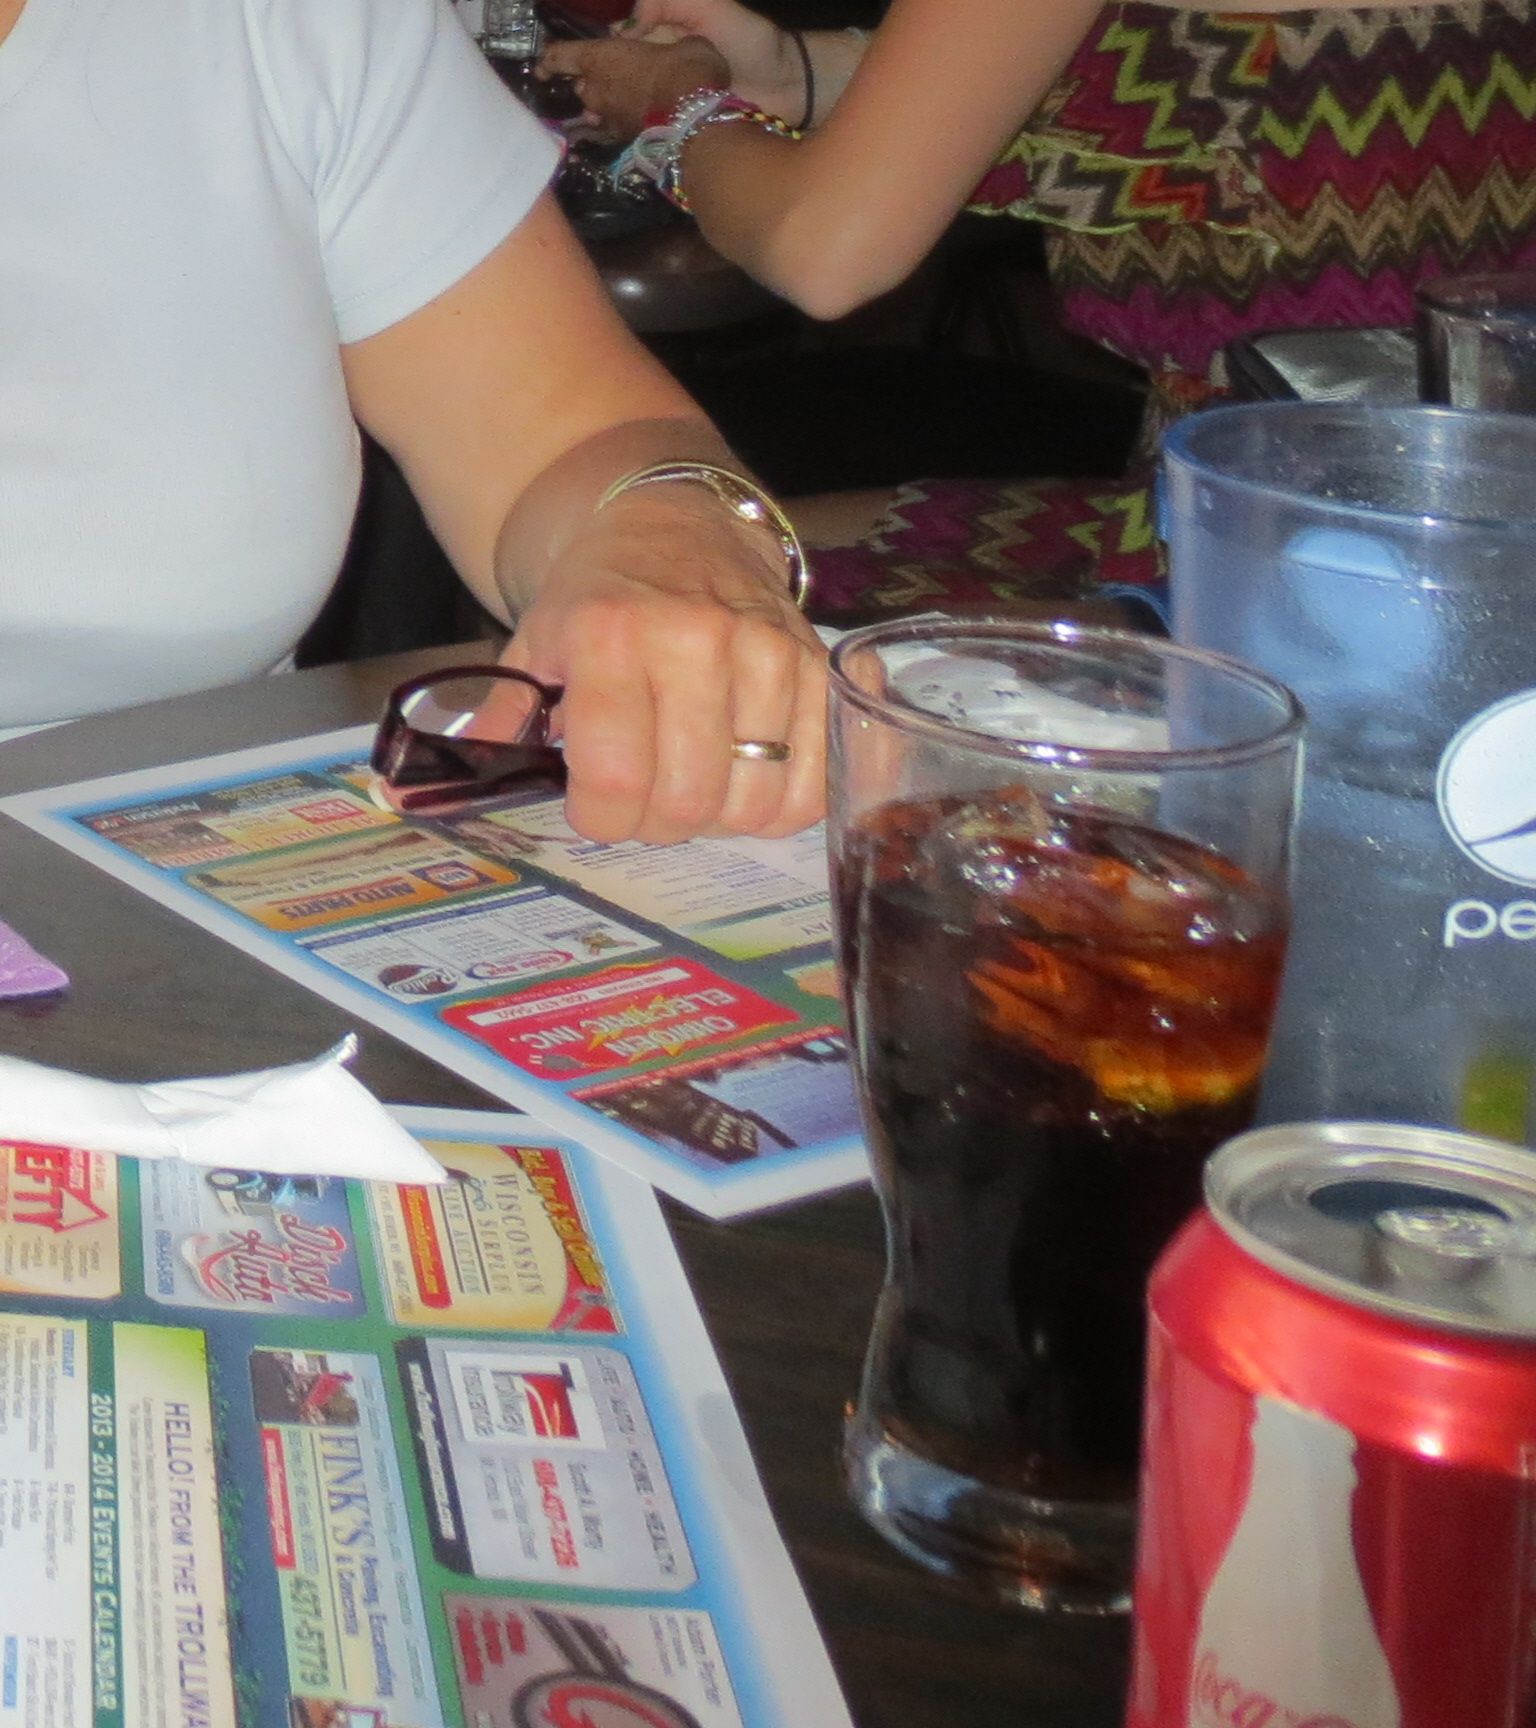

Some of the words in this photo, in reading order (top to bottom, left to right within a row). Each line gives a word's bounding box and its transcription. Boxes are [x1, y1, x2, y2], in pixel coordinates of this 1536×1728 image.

[277, 893, 352, 921] PARTS
[354, 882, 416, 905] AUTO
[580, 988, 736, 1035] ELECTRIC
[229, 1229, 289, 1305] Auto
[90, 1393, 113, 1437] 2013
[164, 1401, 196, 1485] HELLO!
[92, 1452, 115, 1500] 2014
[319, 1433, 375, 1549] FINK'S
[628, 1450, 655, 1496] HOME
[169, 1487, 193, 1546] FROM
[93, 1506, 116, 1585] EVENTS
[173, 1553, 198, 1595] THE
[95, 1591, 118, 1711] CALENDAR
